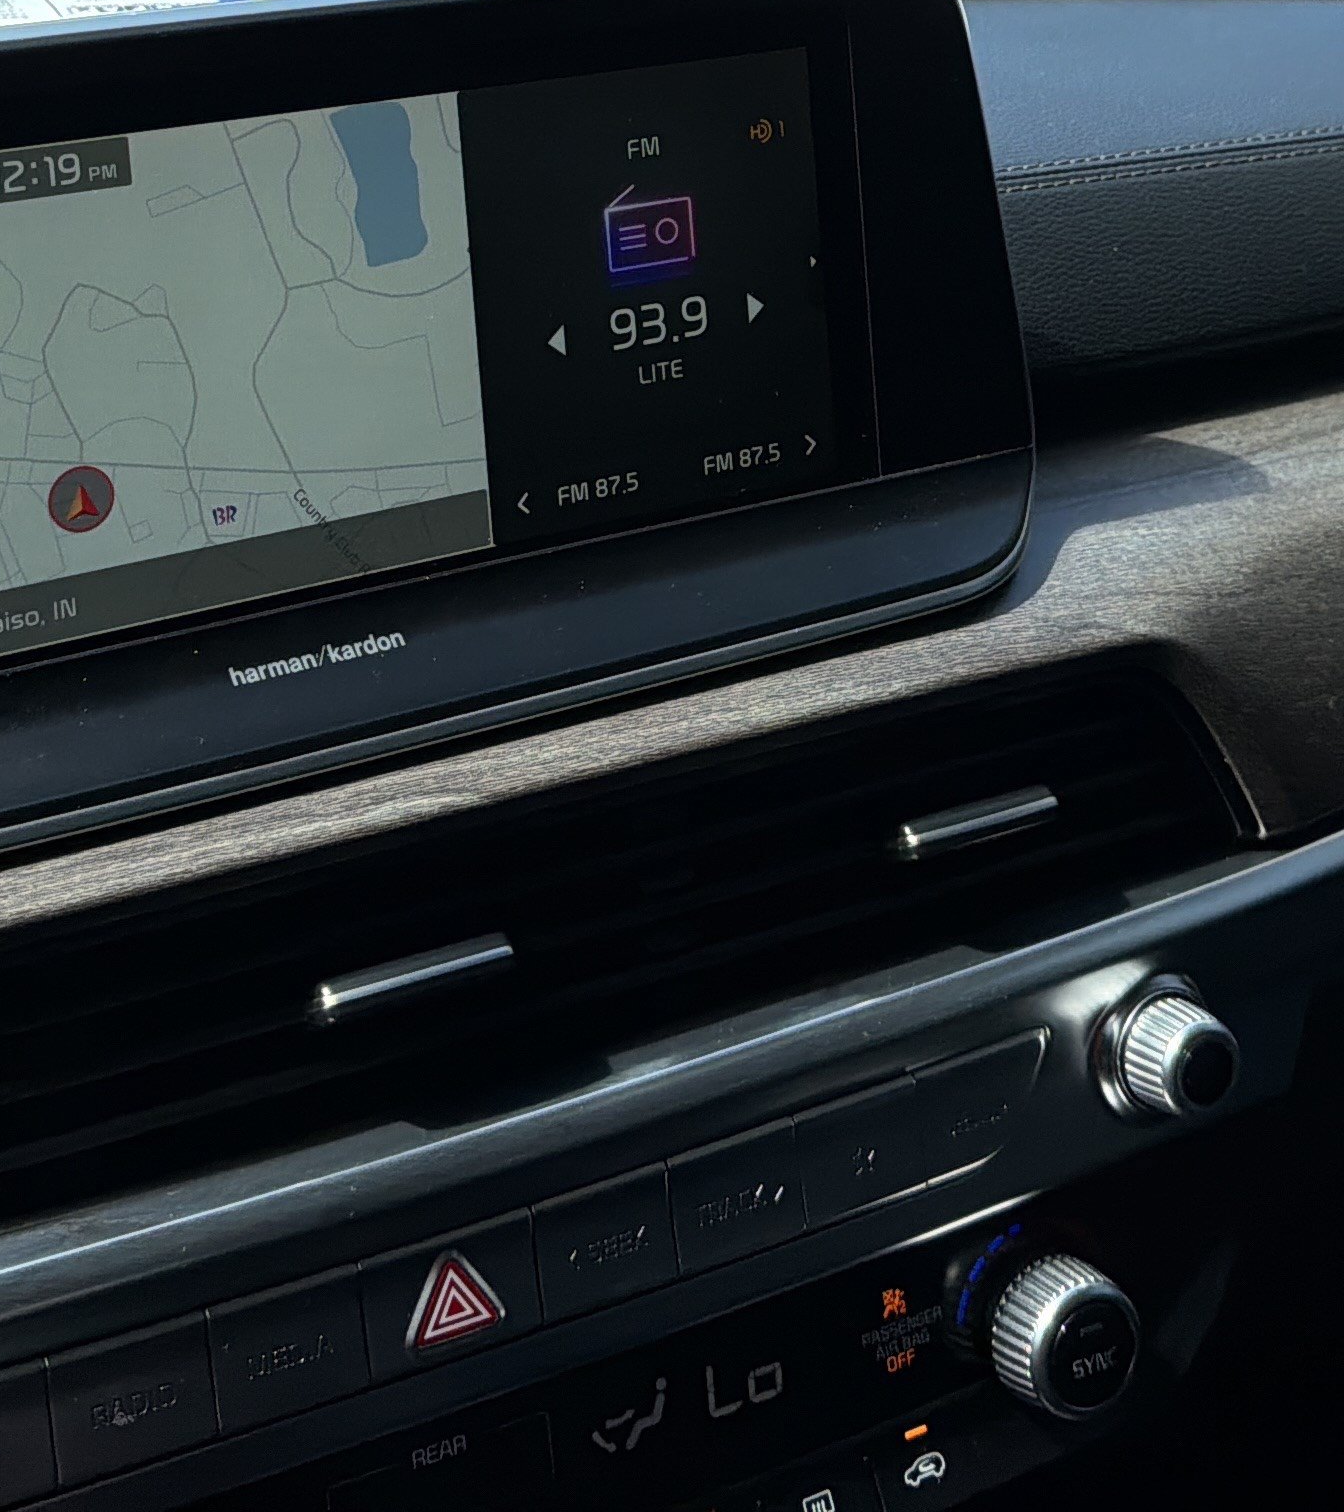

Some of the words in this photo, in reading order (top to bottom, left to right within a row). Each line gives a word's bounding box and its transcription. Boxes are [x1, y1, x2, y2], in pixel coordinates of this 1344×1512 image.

[626, 136, 660, 161] FM
[87, 162, 118, 182] PM
[609, 295, 709, 352] 93.9
[638, 359, 684, 385] LITE
[703, 451, 735, 476] FM
[738, 443, 782, 469] 87.5
[557, 481, 590, 507] FM
[594, 472, 641, 499] 87.5
[211, 504, 238, 527] BR
[293, 487, 338, 546] Country
[53, 598, 78, 621] IN
[229, 629, 406, 688] harman/kardon
[886, 1347, 917, 1374] OFF
[1071, 1345, 1119, 1380] SYNC
[411, 1434, 468, 1469] REAR
